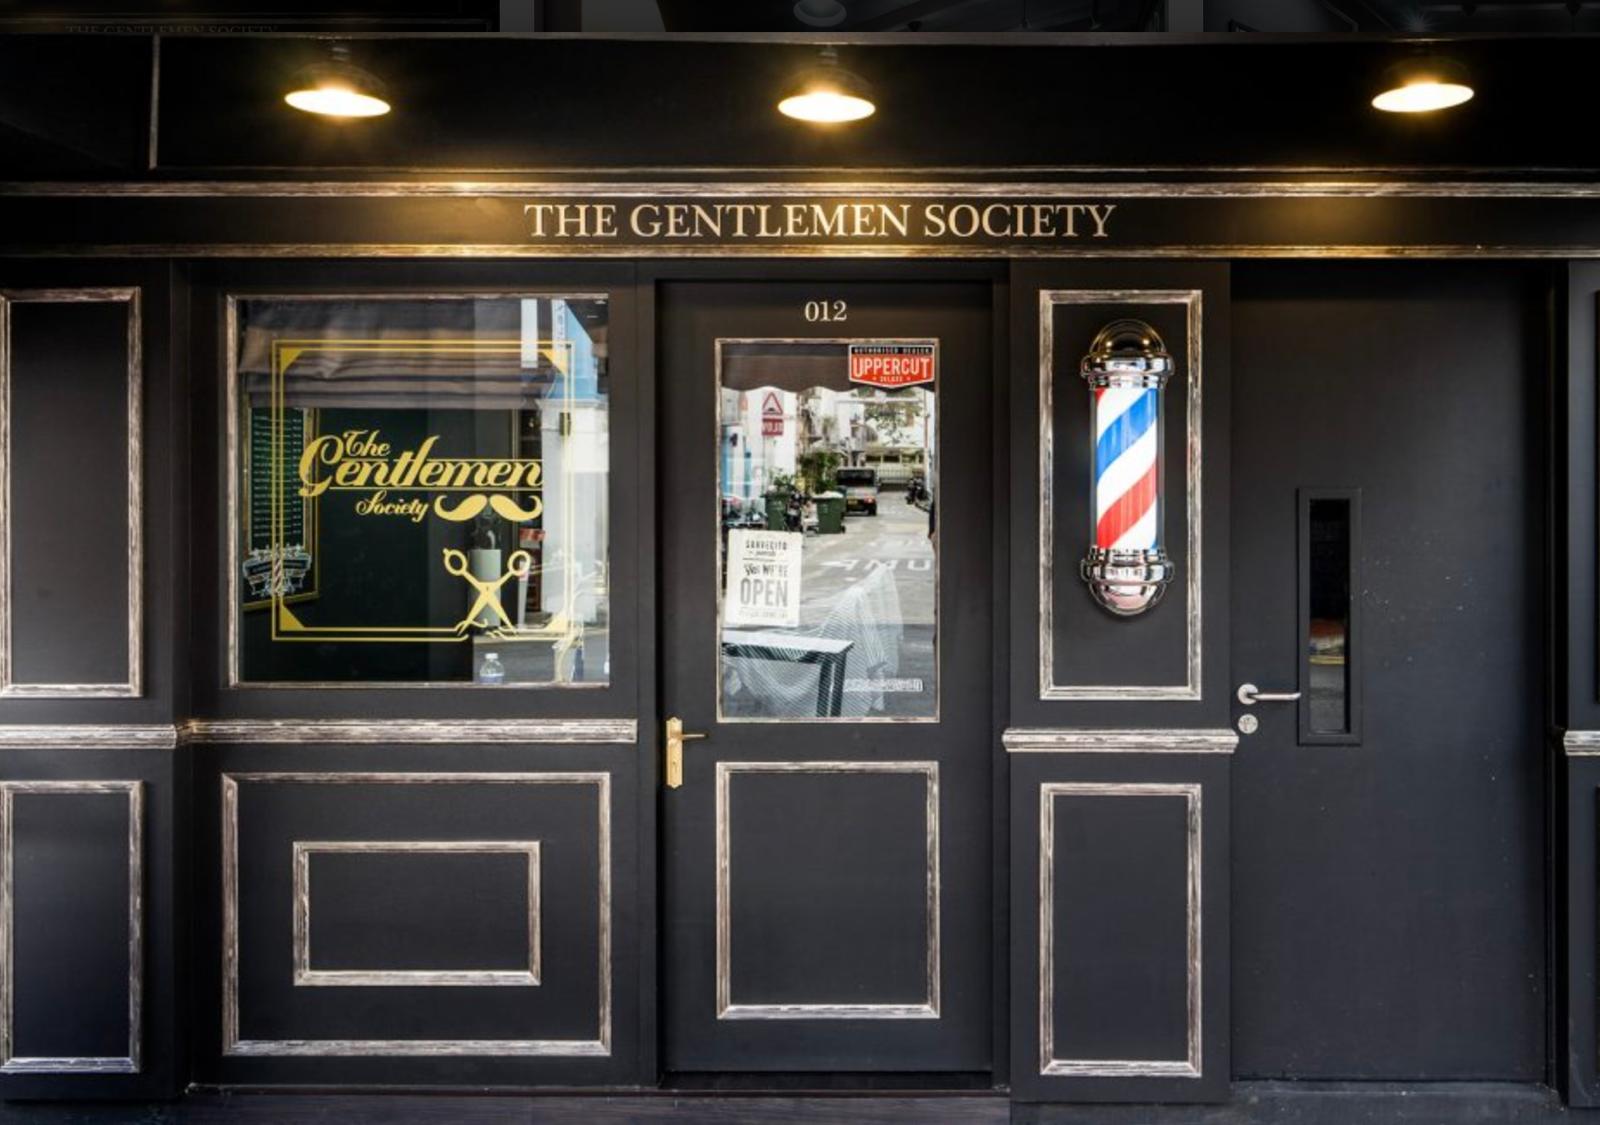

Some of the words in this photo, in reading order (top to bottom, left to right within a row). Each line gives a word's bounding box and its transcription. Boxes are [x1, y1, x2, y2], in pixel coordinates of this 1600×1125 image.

[524, 204, 618, 238] THE
[629, 204, 911, 238] GENTLEMEN
[924, 204, 1117, 238] SOCIETY
[804, 300, 848, 322] 012
[853, 357, 930, 379] UPPERCUT
[343, 429, 391, 457] The
[299, 435, 543, 497] Gentlemen
[355, 489, 429, 523] Society
[740, 578, 788, 608] OPEN
